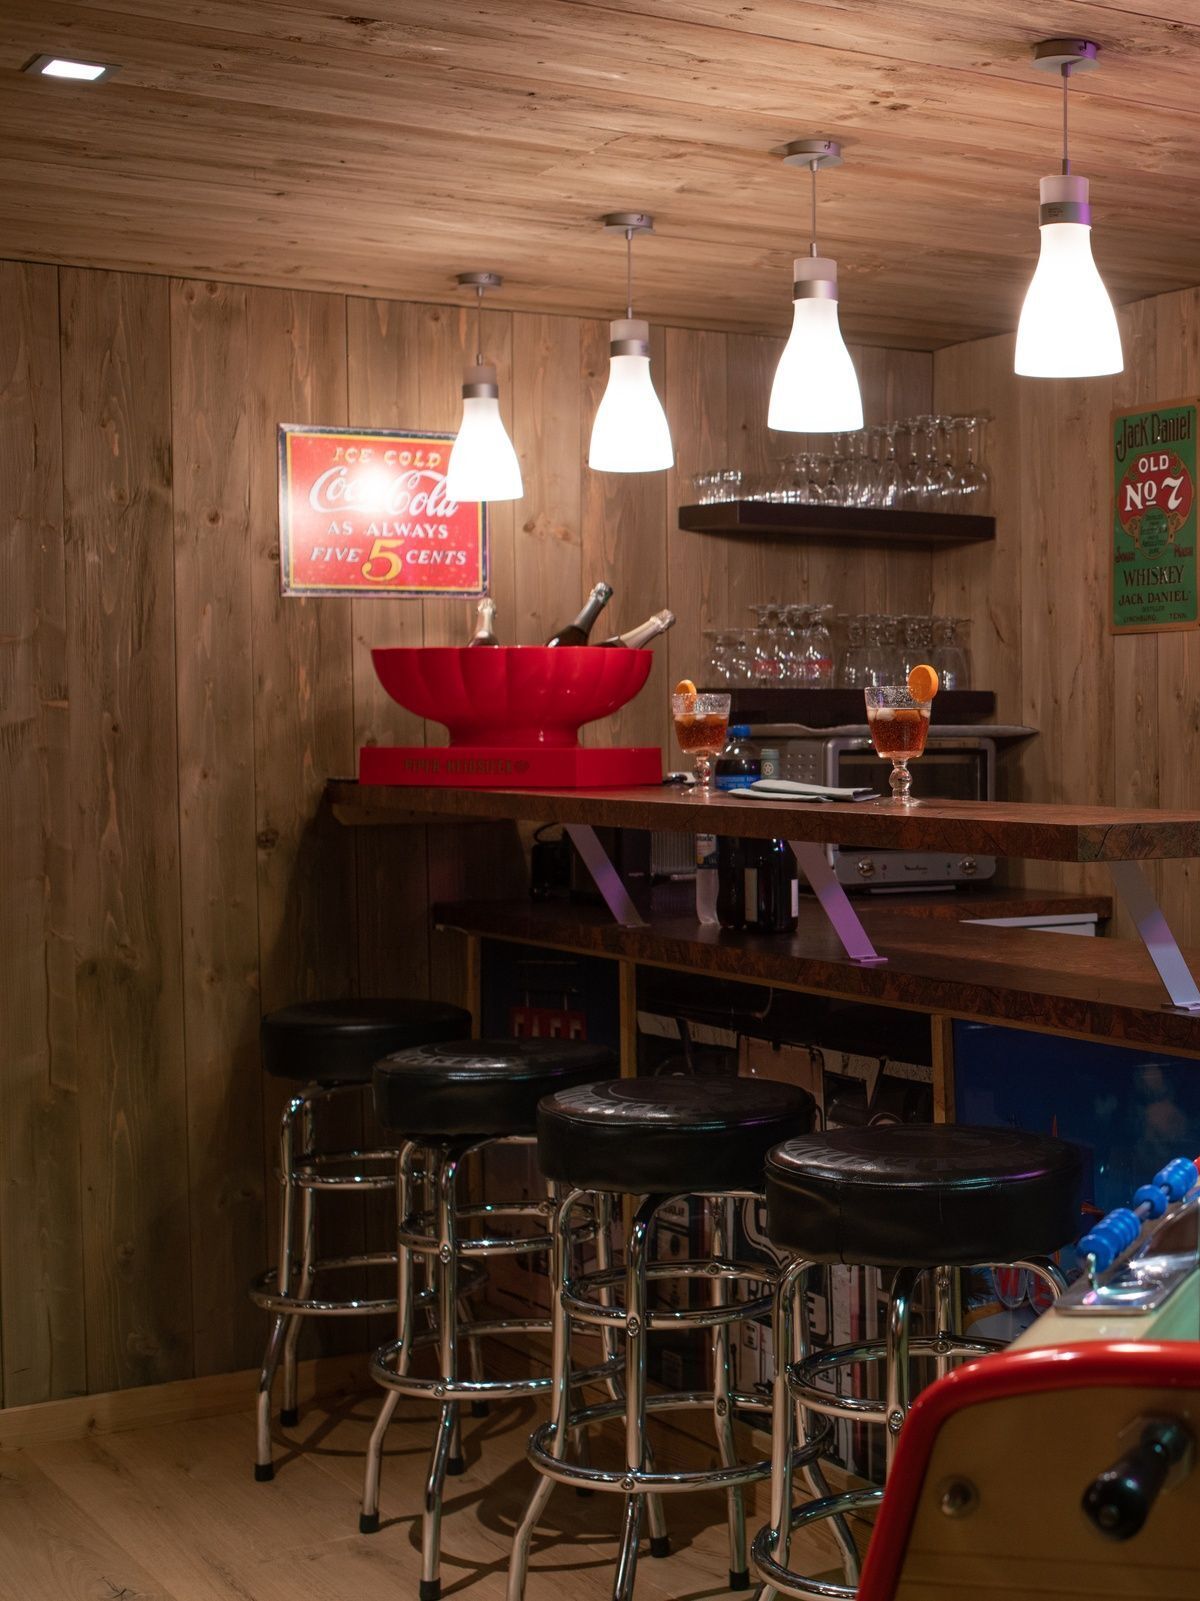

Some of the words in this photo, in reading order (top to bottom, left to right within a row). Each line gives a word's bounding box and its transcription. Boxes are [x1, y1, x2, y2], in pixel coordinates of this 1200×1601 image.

[1116, 416, 1149, 463] Jack
[1151, 410, 1191, 446] Daniel
[333, 446, 375, 464] ICE
[383, 449, 441, 469] COLD
[1138, 454, 1169, 473] OLD
[1161, 475, 1185, 511] 7
[328, 520, 353, 536] AS
[366, 523, 449, 540] ALWAYS
[310, 546, 363, 563] FIVE
[361, 538, 405, 581] 5
[406, 549, 467, 565] CENTS
[1123, 566, 1185, 588] WHISKEY
[1118, 591, 1144, 607] JACK
[1147, 589, 1188, 605] DANIEL
